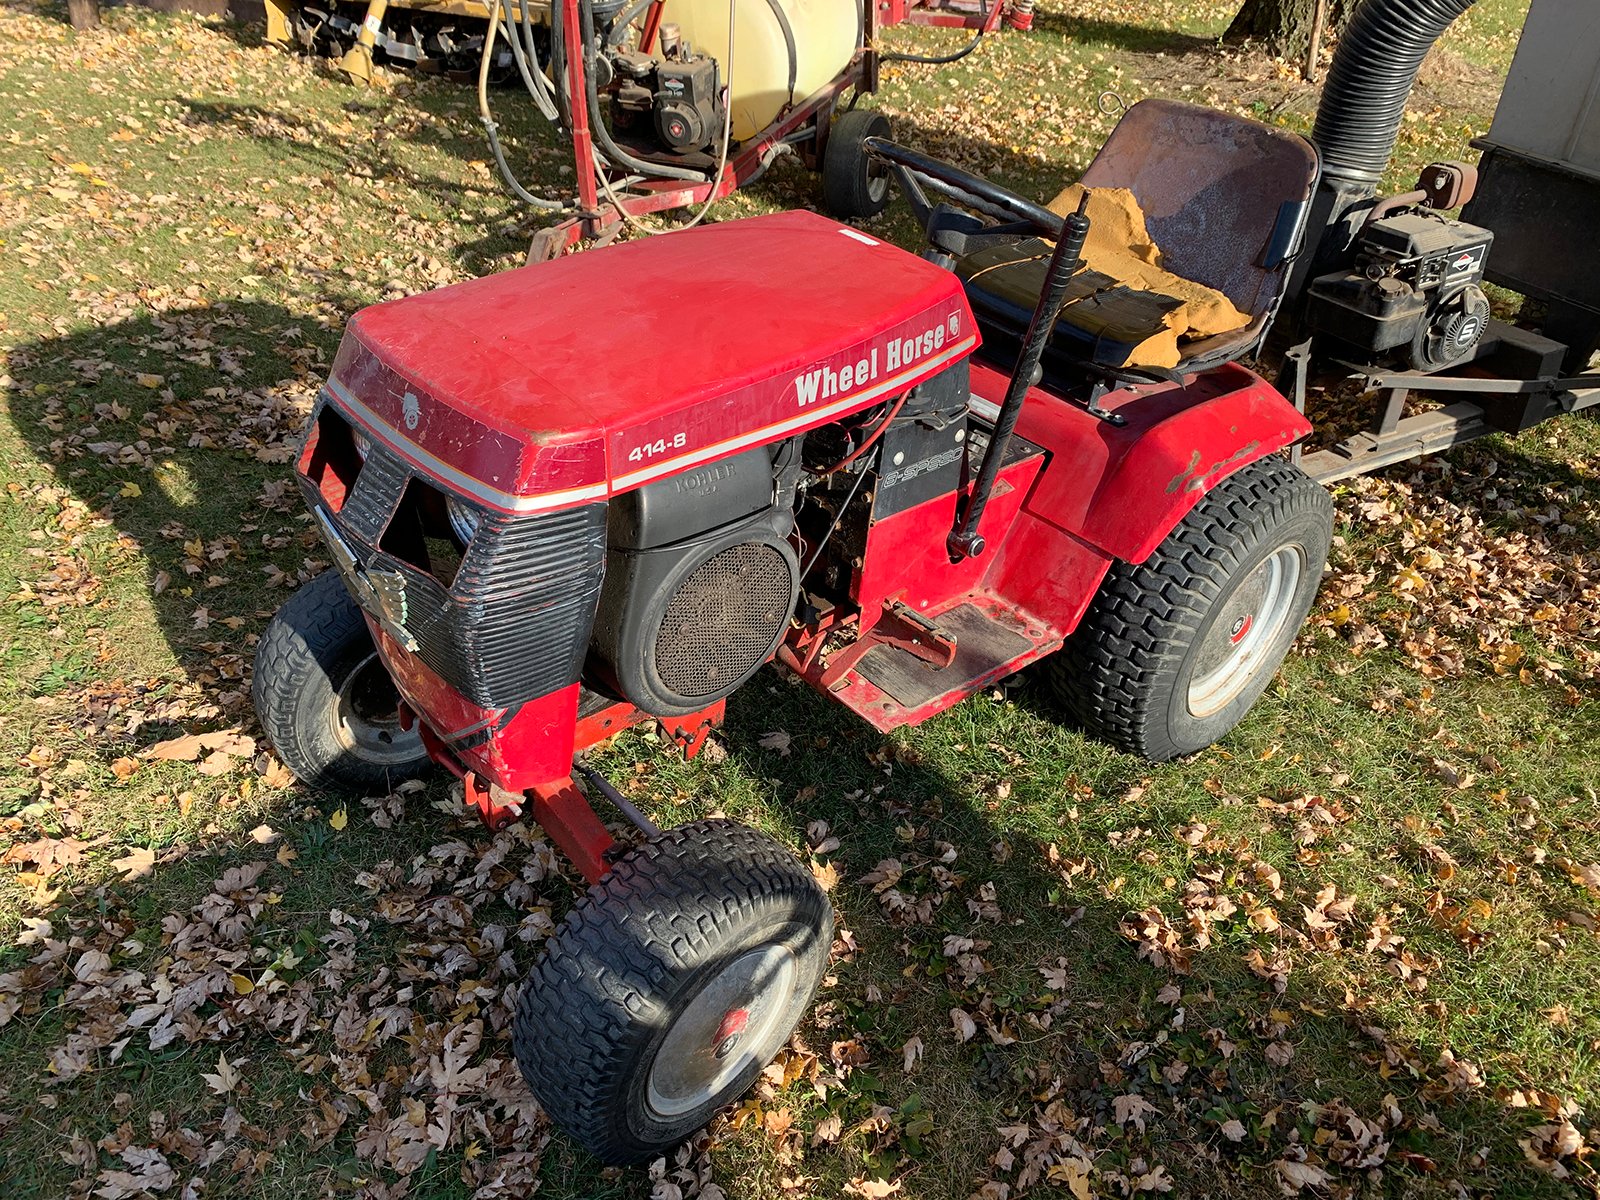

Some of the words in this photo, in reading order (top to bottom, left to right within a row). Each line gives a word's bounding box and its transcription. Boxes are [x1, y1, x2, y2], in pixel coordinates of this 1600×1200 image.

[795, 348, 878, 407] Wheel
[886, 324, 945, 373] Horse
[628, 432, 687, 462] 414-8
[675, 463, 737, 493] KOHLER
[883, 446, 964, 488] 8-SPEED
